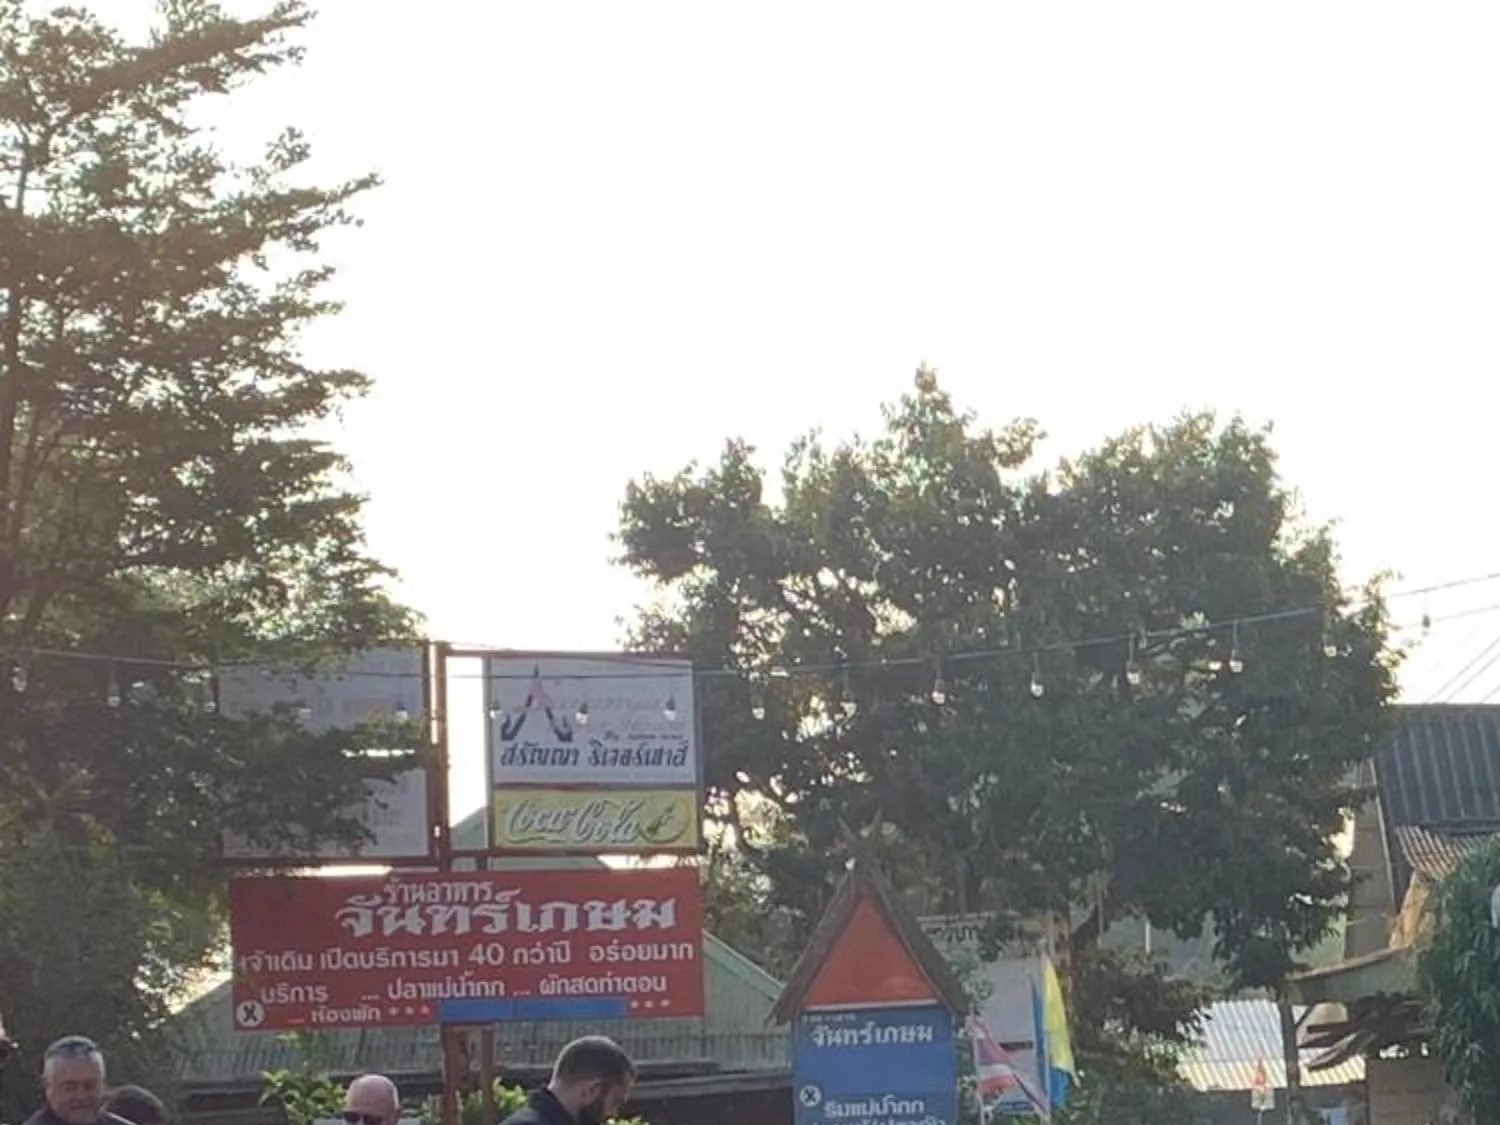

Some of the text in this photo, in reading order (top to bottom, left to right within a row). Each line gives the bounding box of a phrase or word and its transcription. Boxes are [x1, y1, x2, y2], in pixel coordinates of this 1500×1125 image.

[335, 888, 677, 938] จันทร์เกษม
[468, 942, 505, 966] 40
